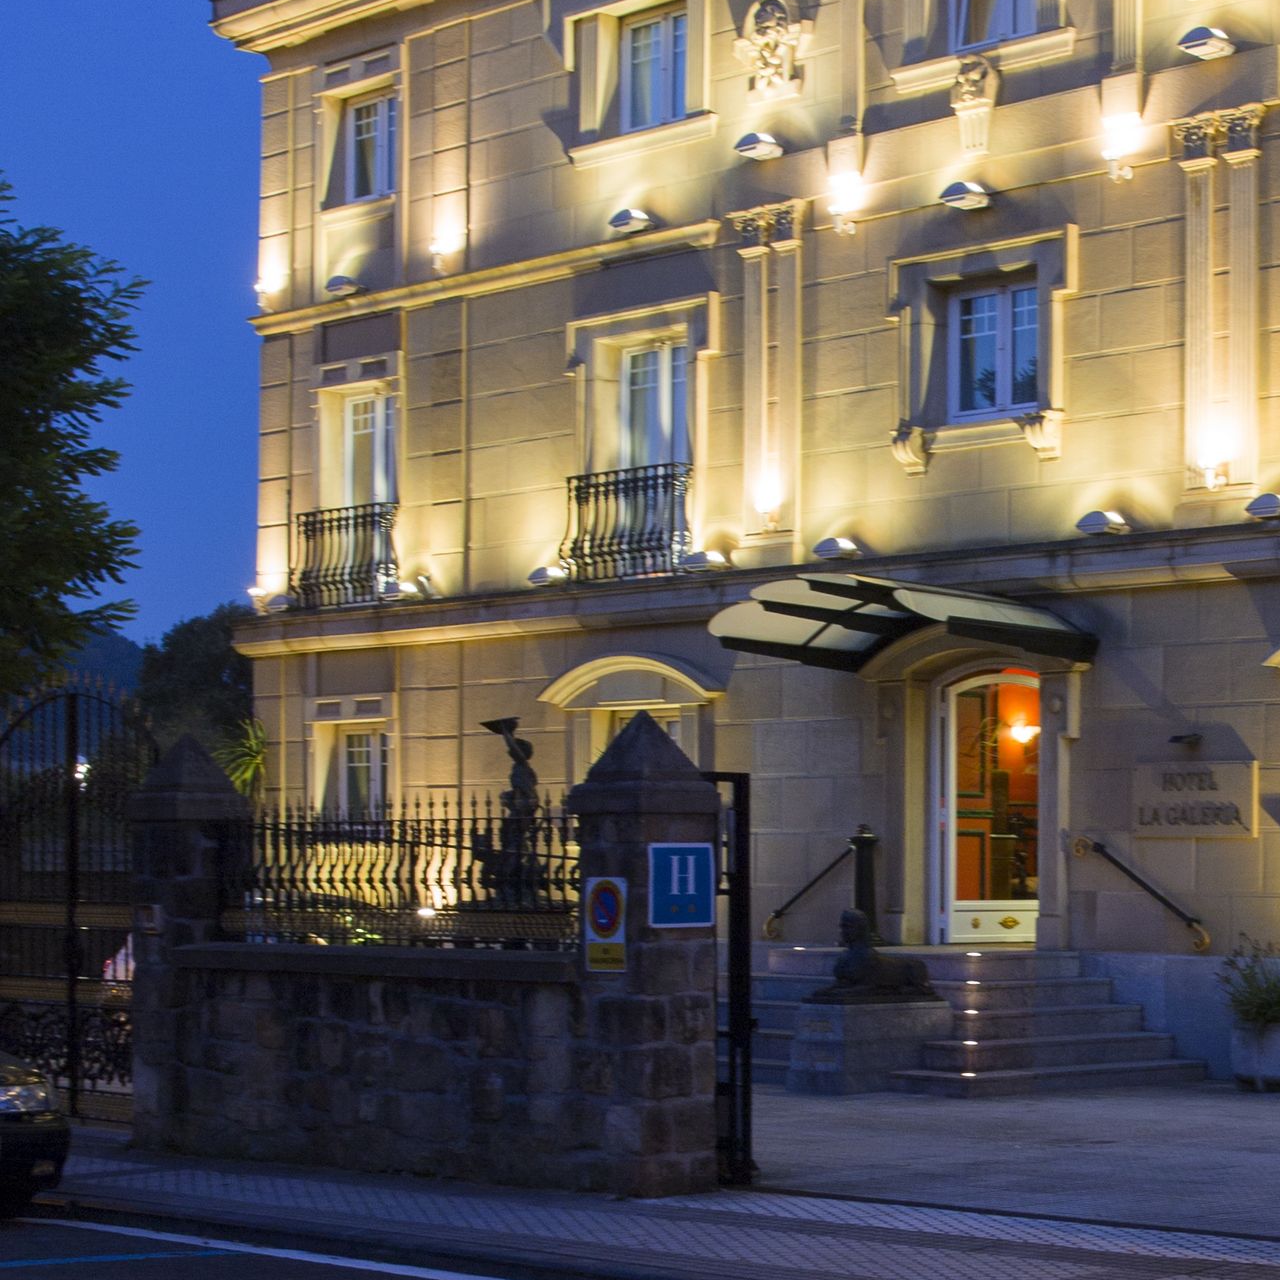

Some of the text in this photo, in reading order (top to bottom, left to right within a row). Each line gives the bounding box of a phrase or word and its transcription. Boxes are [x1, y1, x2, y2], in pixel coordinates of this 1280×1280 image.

[1162, 771, 1218, 791] HOTEL
[1139, 807, 1162, 825] LA
[669, 855, 697, 895] H
